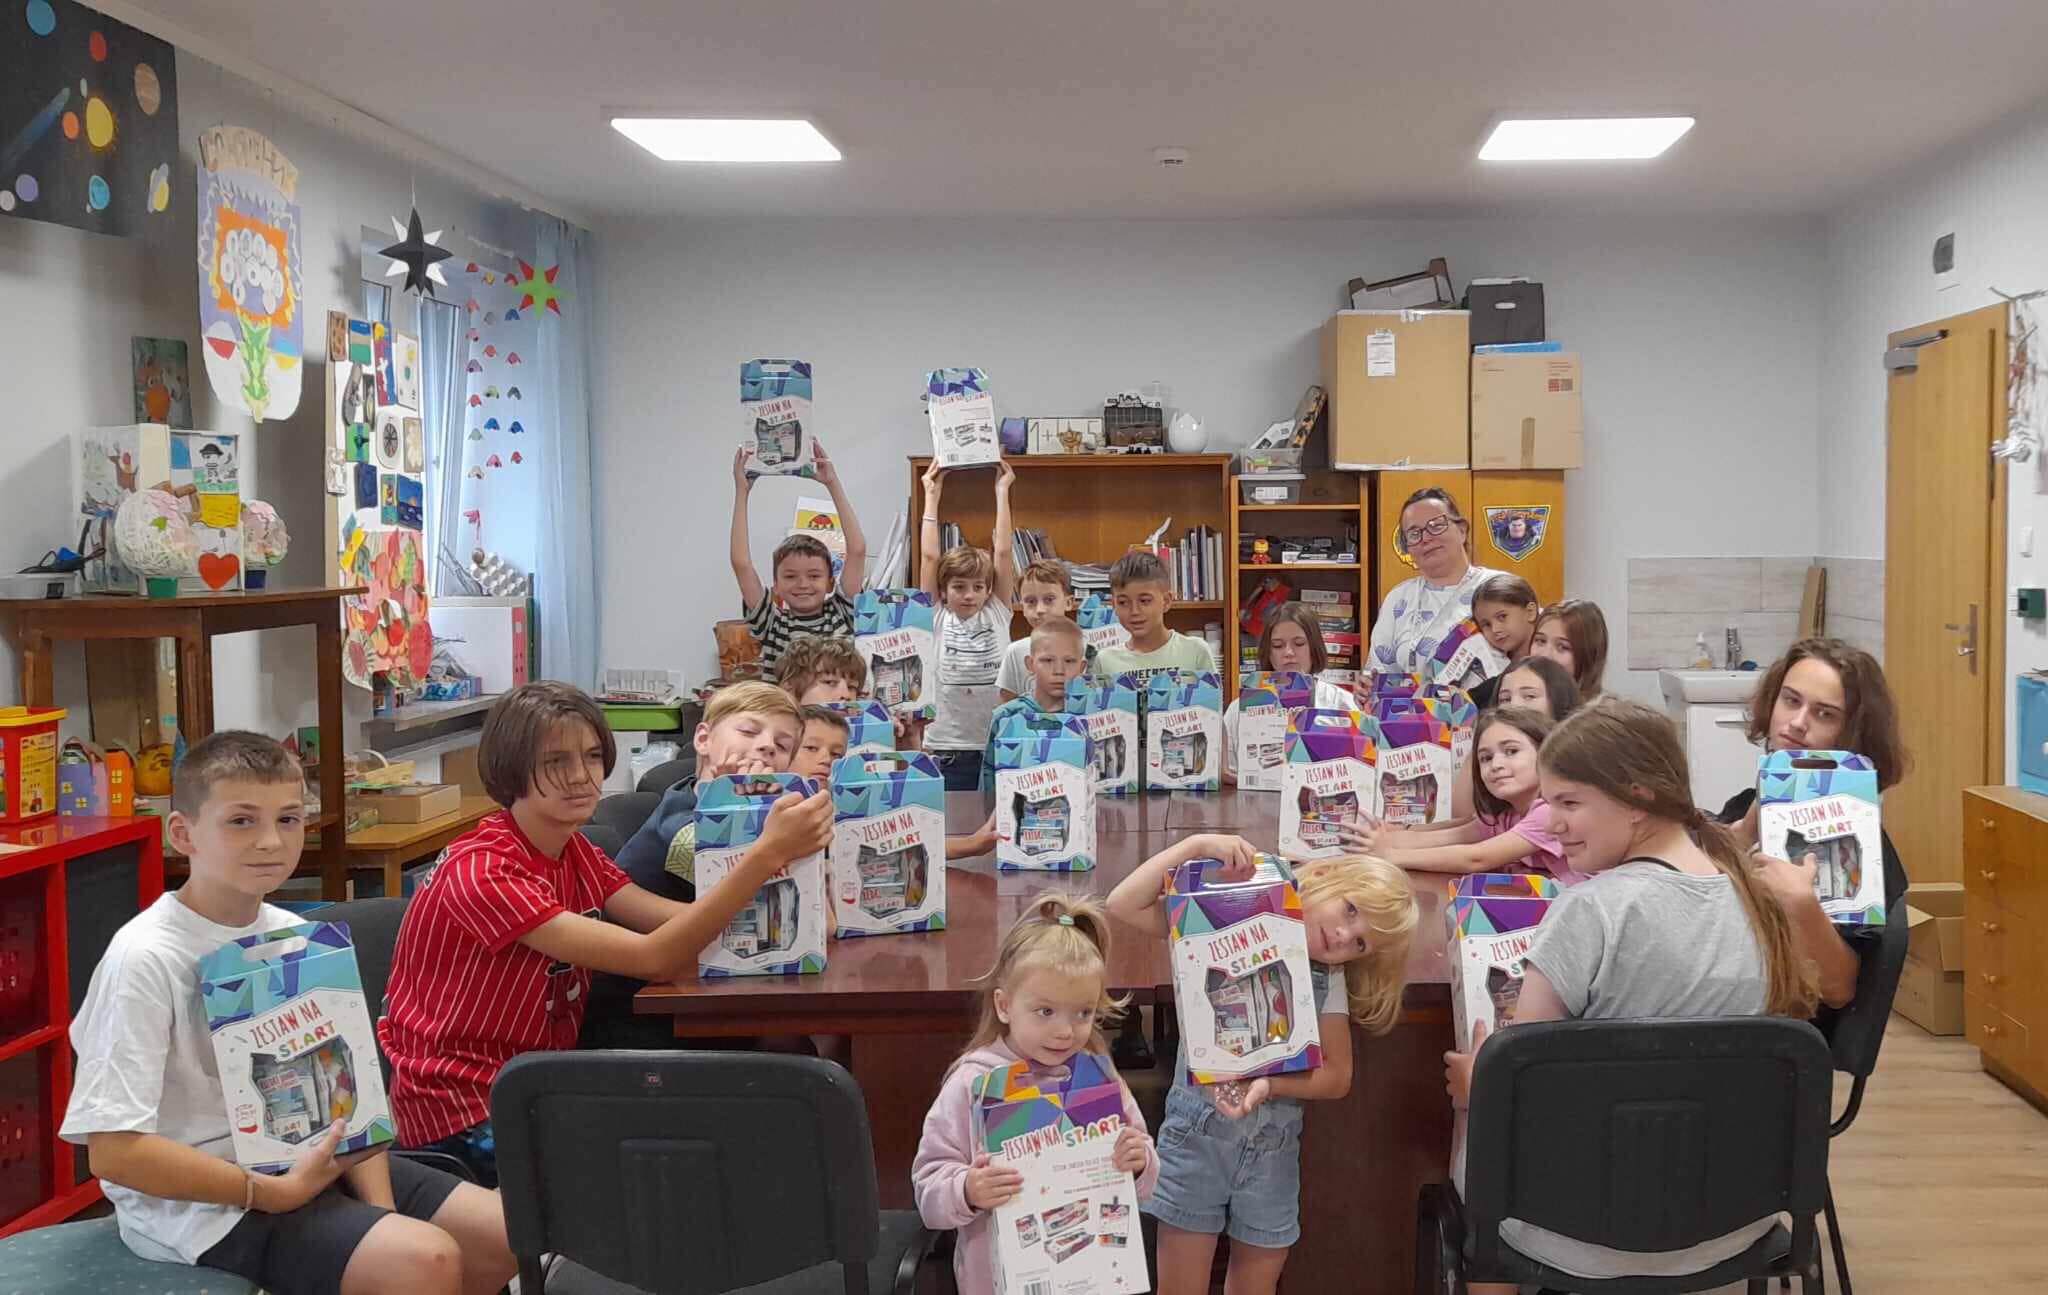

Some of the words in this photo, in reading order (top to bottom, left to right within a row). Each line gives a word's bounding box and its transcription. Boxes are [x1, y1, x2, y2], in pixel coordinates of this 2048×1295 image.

[873, 635, 899, 652] ZESTAW
[900, 631, 912, 644] NA
[1385, 751, 1413, 769] ZESTAW
[1413, 747, 1426, 761] NA
[1016, 770, 1044, 790] ZESTAW
[1045, 767, 1058, 782] NA
[1305, 766, 1333, 784] ZESTAW
[1335, 763, 1349, 777] NA
[862, 817, 897, 842] ZESTAW
[898, 811, 914, 830] NA
[1790, 804, 1826, 827] ZESTAW
[1827, 800, 1846, 819] NA
[880, 831, 920, 853] ST.ART
[1808, 821, 1852, 839] ST.ART
[1208, 929, 1249, 962] ZESTAW
[1249, 922, 1270, 945] NA
[1490, 937, 1529, 962] ZESTAW
[1231, 944, 1280, 974] ST.ART
[250, 1008, 300, 1049] ZESTAW
[299, 999, 322, 1024] NA
[278, 1020, 336, 1058] ST.ART
[1003, 1131, 1042, 1161] ZESTAW
[1042, 1125, 1060, 1148] NA
[1065, 1116, 1120, 1148] ST.ART
